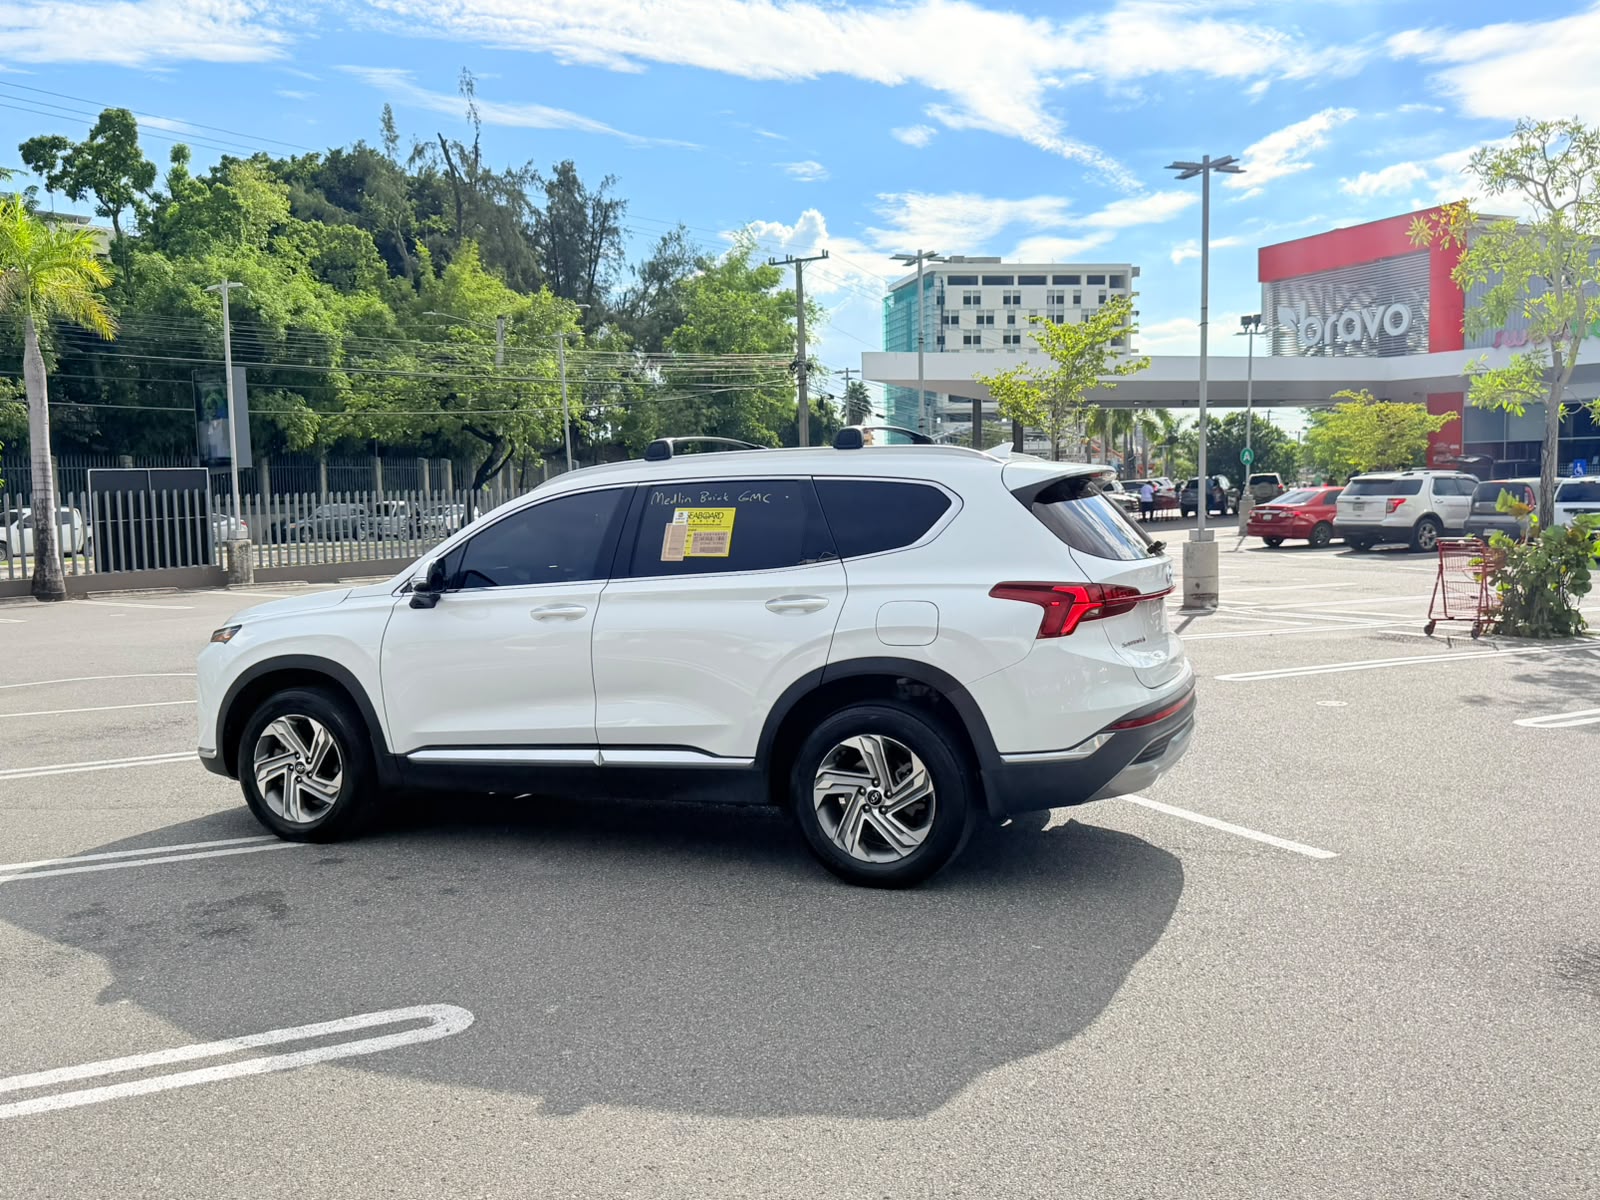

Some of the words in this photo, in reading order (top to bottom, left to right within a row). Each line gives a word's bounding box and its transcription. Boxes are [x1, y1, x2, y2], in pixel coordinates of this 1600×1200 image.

[1299, 300, 1412, 347] bravo
[650, 491, 692, 505] Medlin
[738, 490, 773, 504] GMC
